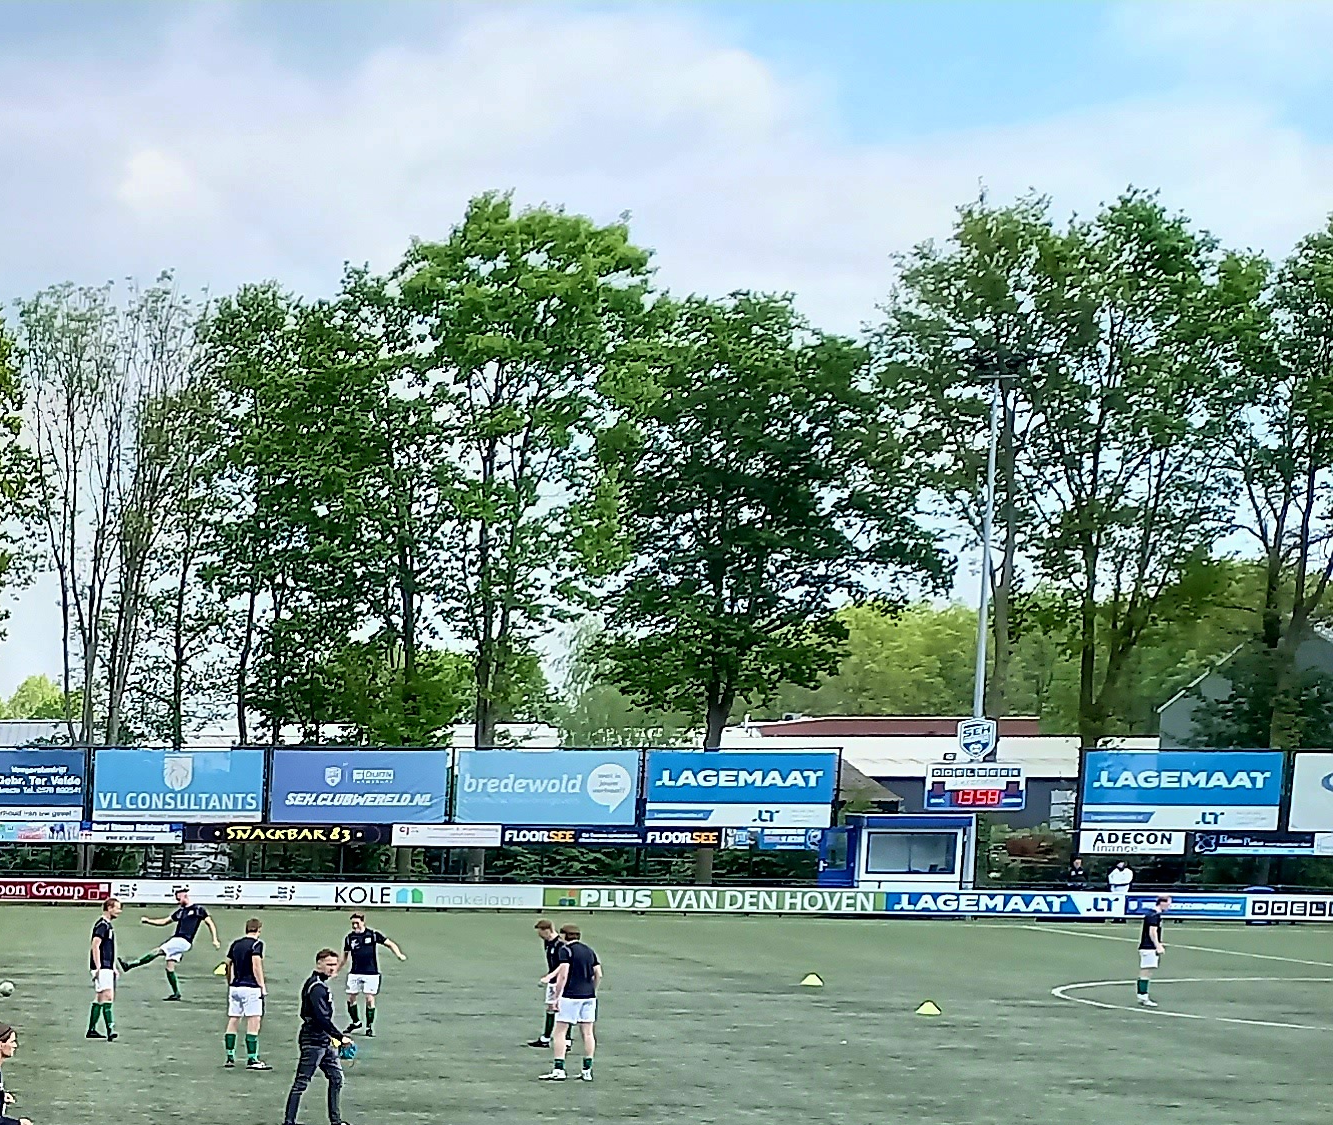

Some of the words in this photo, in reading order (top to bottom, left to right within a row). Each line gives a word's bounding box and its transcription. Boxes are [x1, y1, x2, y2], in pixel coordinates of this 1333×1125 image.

[963, 726, 990, 738] SEH
[30, 775, 46, 785] Ter
[51, 774, 81, 785] Velde
[463, 773, 582, 793] bredewold
[98, 792, 122, 809] VL
[126, 792, 257, 810] CONSULTANTS
[285, 792, 431, 806] SEH.CLUBWERELD.NL
[226, 826, 327, 840] SNACKBAR
[329, 827, 351, 842] 83
[1094, 832, 1172, 844] ADECON
[32, 882, 85, 898] Group
[334, 887, 392, 904] KOLE
[436, 893, 524, 907] makelaars
[580, 889, 653, 908] PLUS
[665, 890, 719, 909] VAN
[724, 890, 780, 910] DEN
[785, 891, 875, 911] HOVEN
